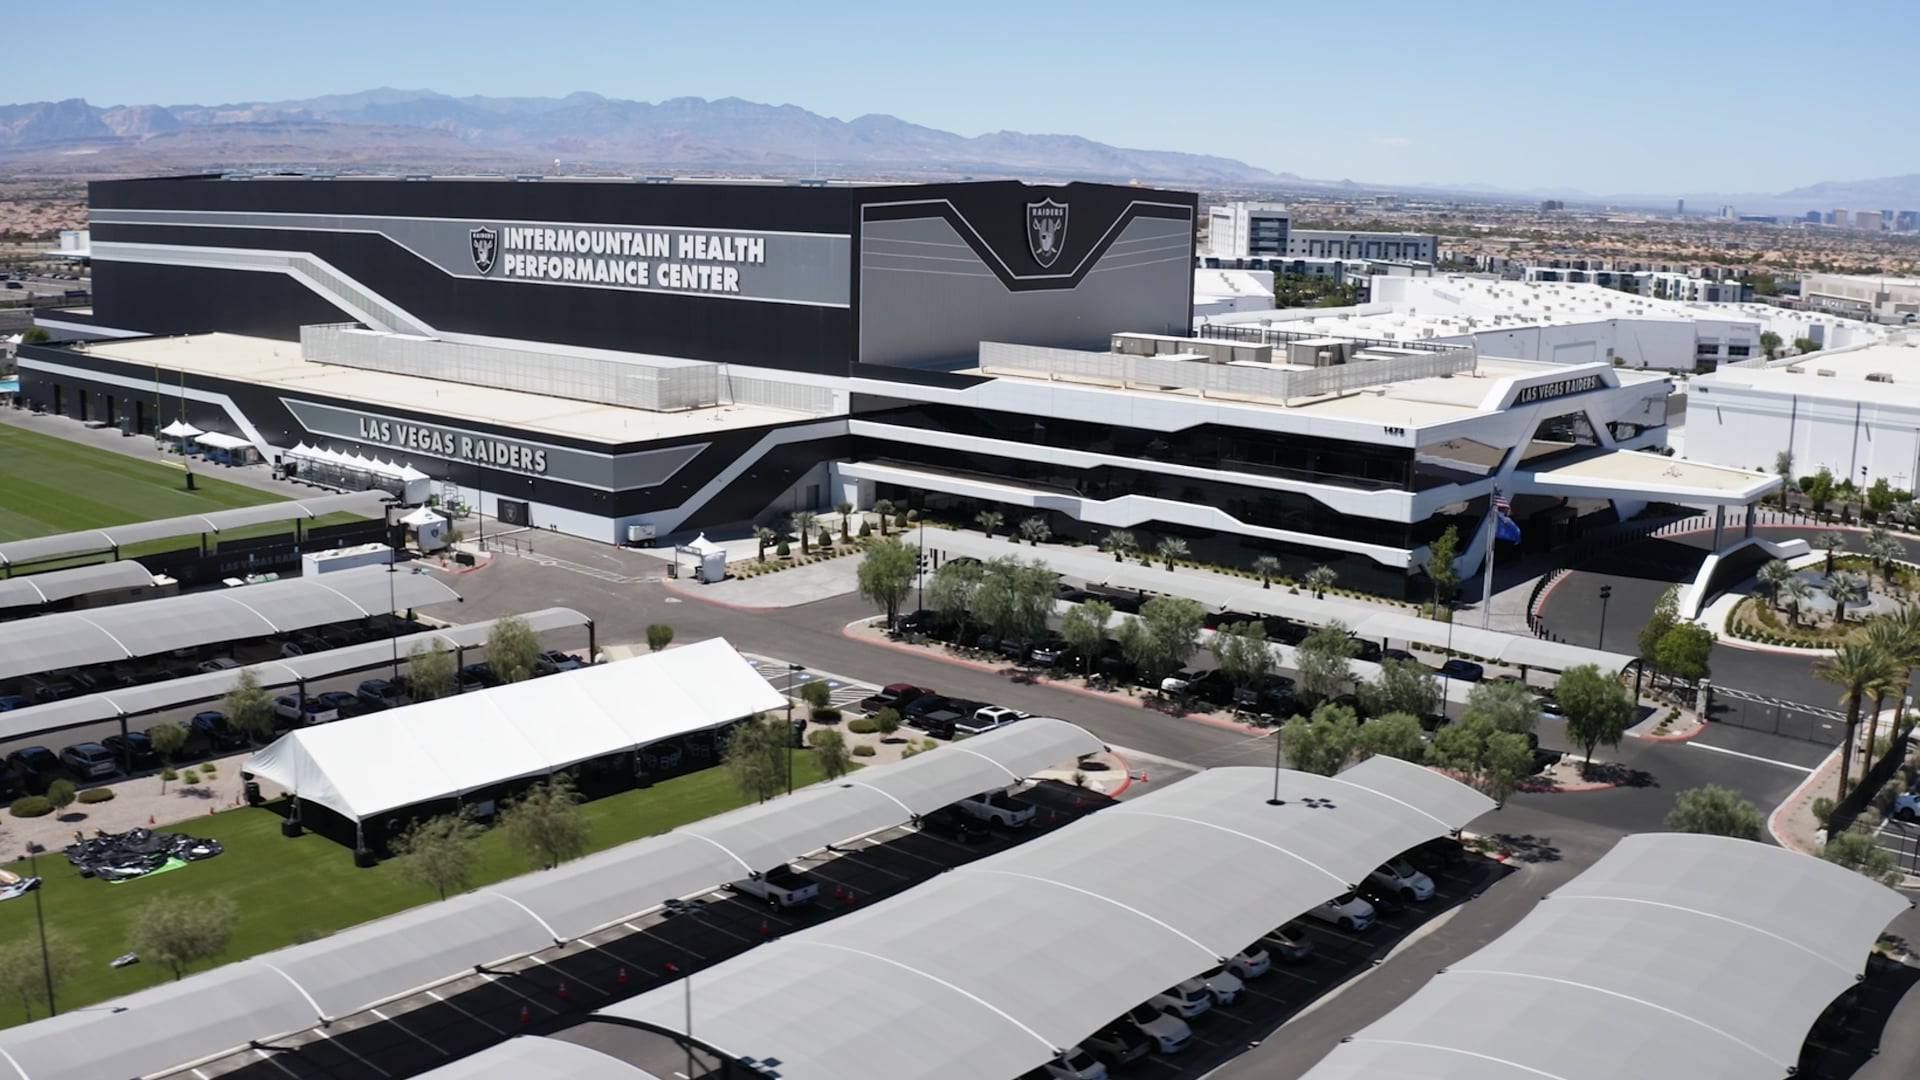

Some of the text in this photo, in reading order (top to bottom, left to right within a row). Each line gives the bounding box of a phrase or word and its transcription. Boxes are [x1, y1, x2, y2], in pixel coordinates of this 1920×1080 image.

[1032, 208, 1064, 216] RAIDERS
[504, 227, 765, 263] INTERMOUNTAIN HEALTH
[504, 255, 739, 292] PERFORMANCE CENTER
[1521, 375, 1596, 403] LAS VEGAS RAIDERS
[359, 417, 547, 473] LAS VEGAS RAIDERS
